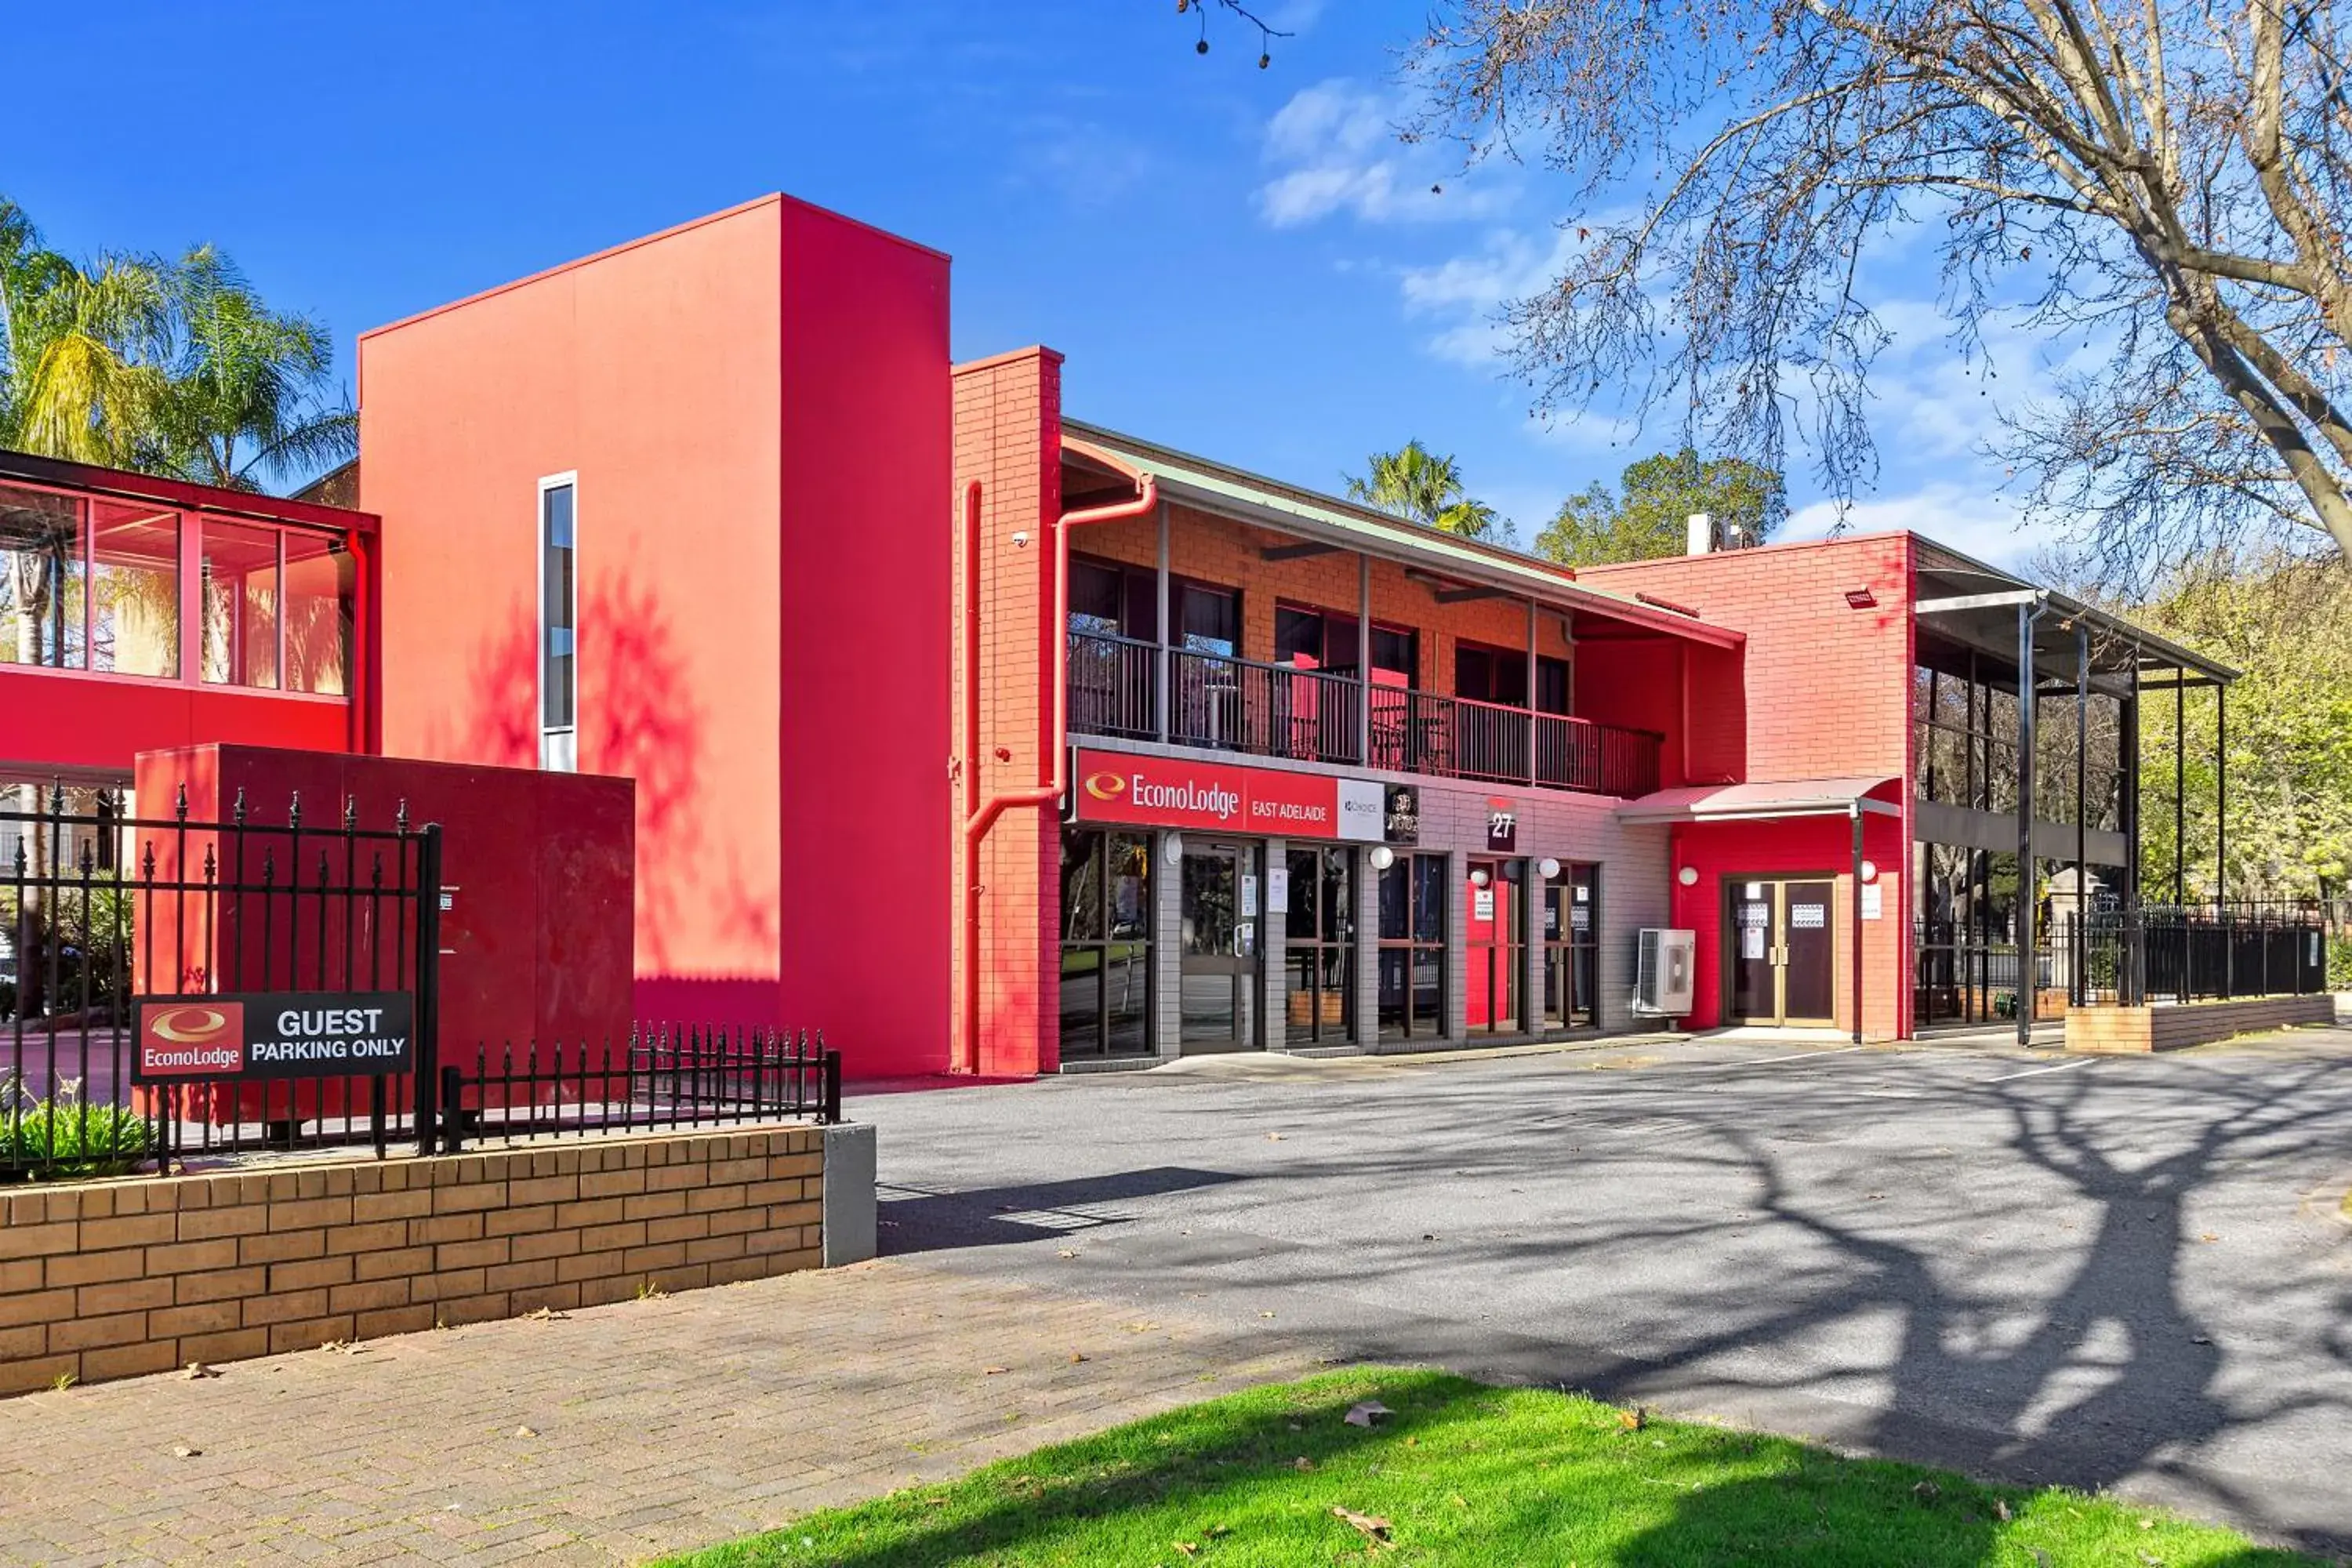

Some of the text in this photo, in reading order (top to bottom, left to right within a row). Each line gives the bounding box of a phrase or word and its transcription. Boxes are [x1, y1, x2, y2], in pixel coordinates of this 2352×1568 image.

[1133, 774, 1239, 819] EconoLodge
[1252, 800, 1327, 821] EAST ADELAIDE
[1492, 812, 1512, 838] 27
[278, 1009, 383, 1036] GUEST
[144, 1047, 239, 1069] EconoLodge
[252, 1038, 405, 1061] PARKING ONLY
